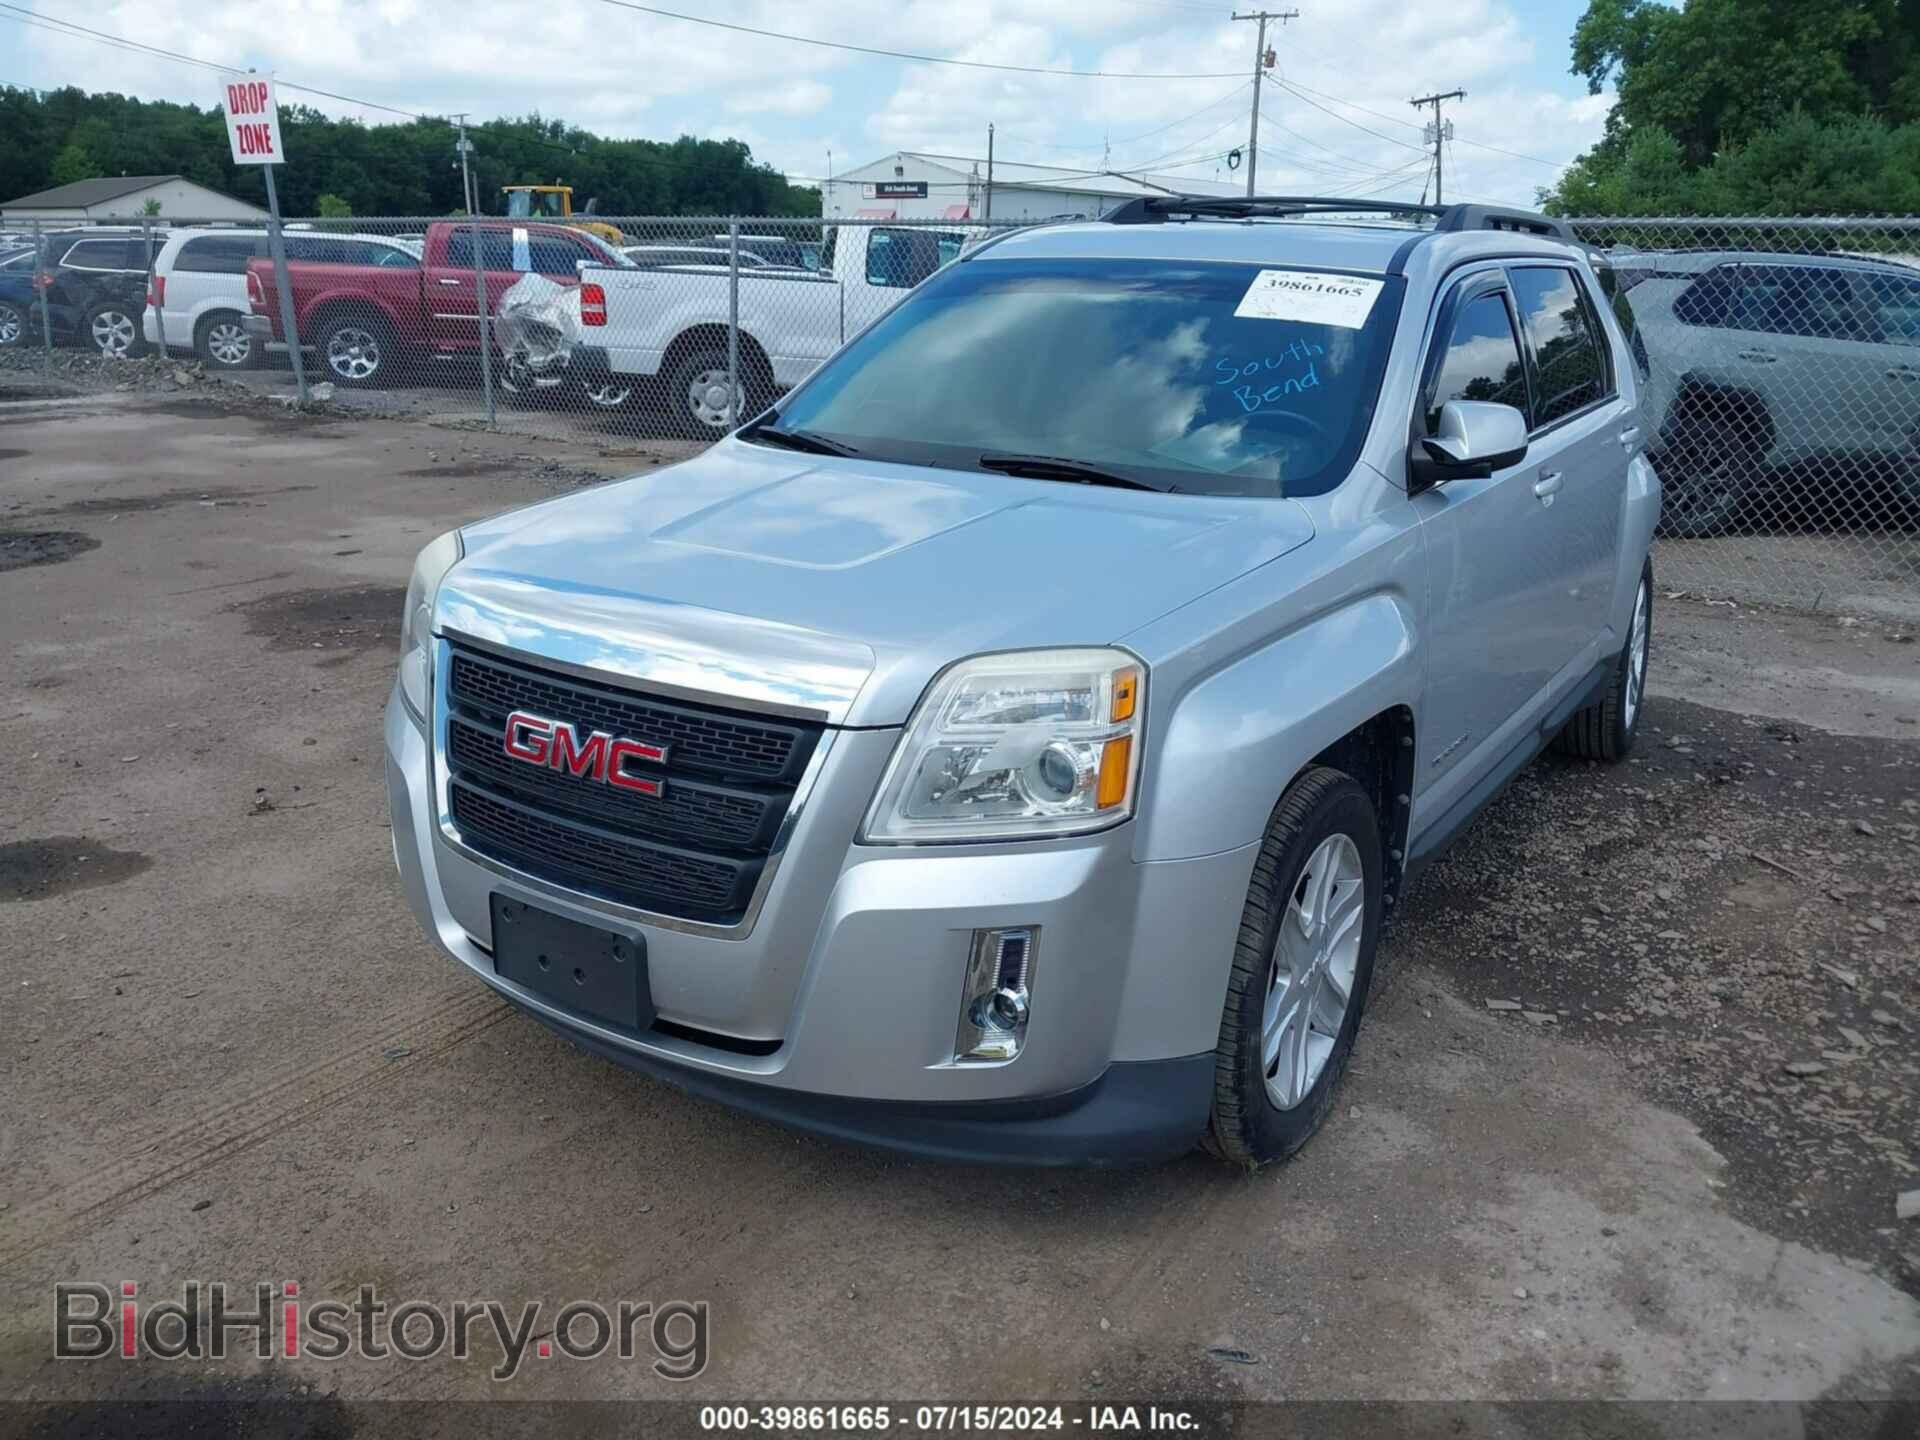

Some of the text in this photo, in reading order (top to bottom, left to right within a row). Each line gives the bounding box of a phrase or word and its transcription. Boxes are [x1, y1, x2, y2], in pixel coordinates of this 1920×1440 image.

[227, 82, 268, 114] DROP
[236, 123, 273, 154] ZONE
[1264, 279, 1364, 297] 39861665
[1215, 338, 1324, 385] South
[1231, 362, 1320, 411] Bend
[504, 710, 668, 799] GMC
